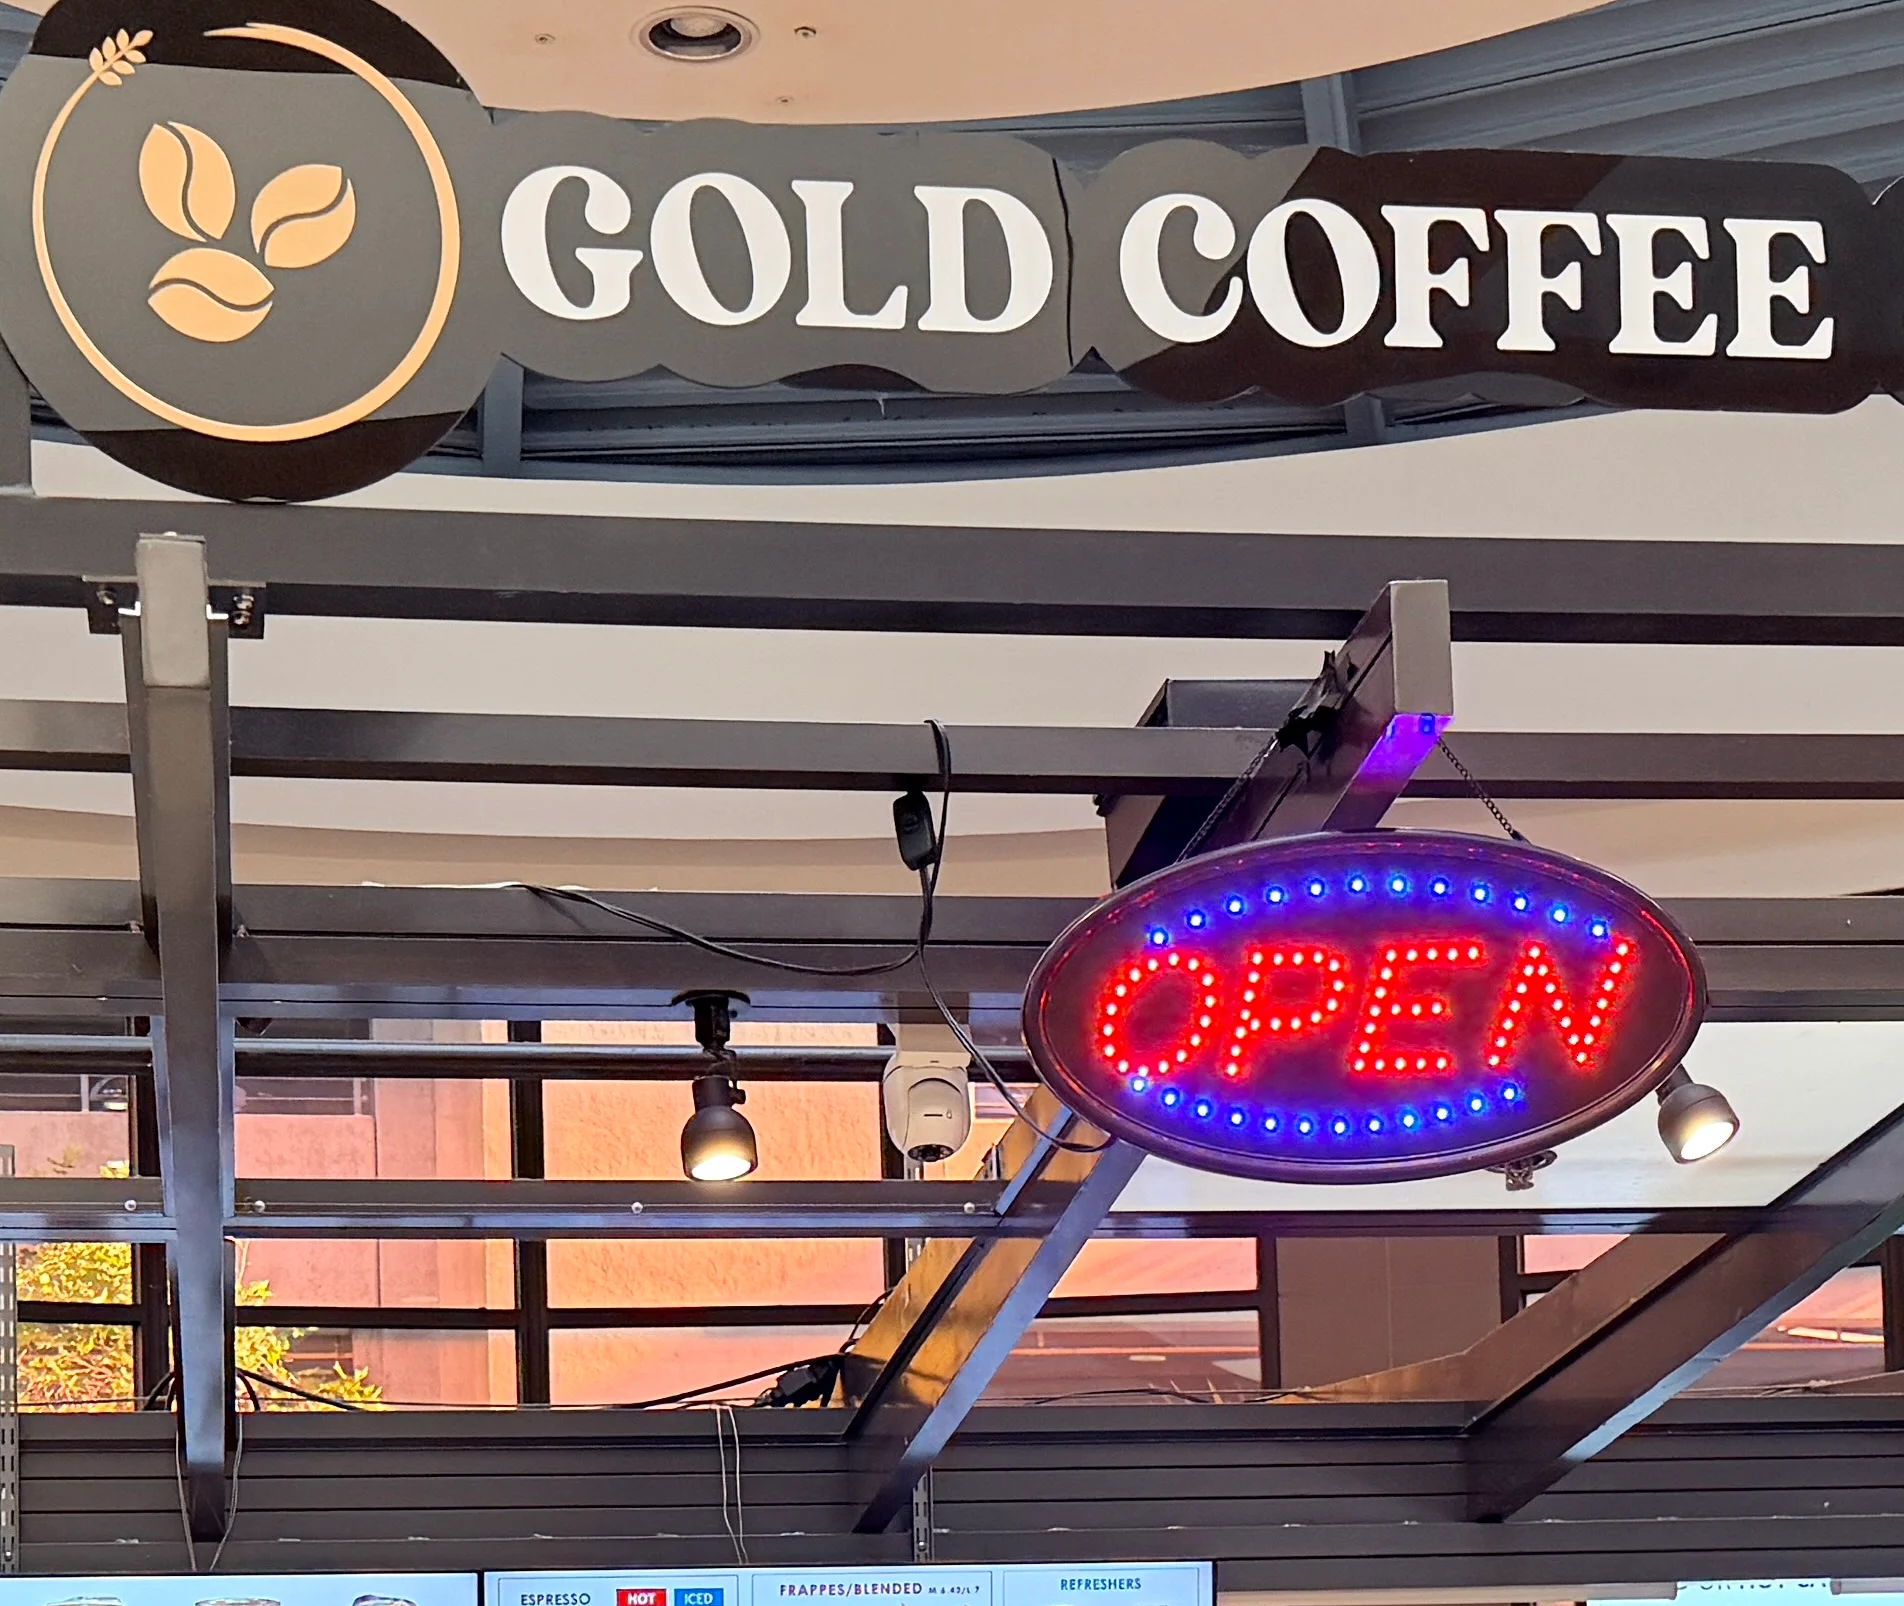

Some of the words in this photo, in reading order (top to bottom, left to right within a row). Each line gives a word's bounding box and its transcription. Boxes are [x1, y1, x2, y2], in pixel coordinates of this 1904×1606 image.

[501, 164, 1054, 335] GOLD
[1118, 191, 1835, 362] COFFEE
[1097, 937, 1638, 1082] OPEN
[780, 1583, 922, 1597] FRAPPES/BLENDED
[1061, 1578, 1142, 1591] REFRESHERS
[521, 1593, 591, 1606] ESPRESSO
[627, 1593, 656, 1605] HOT
[684, 1593, 714, 1605] ICED
